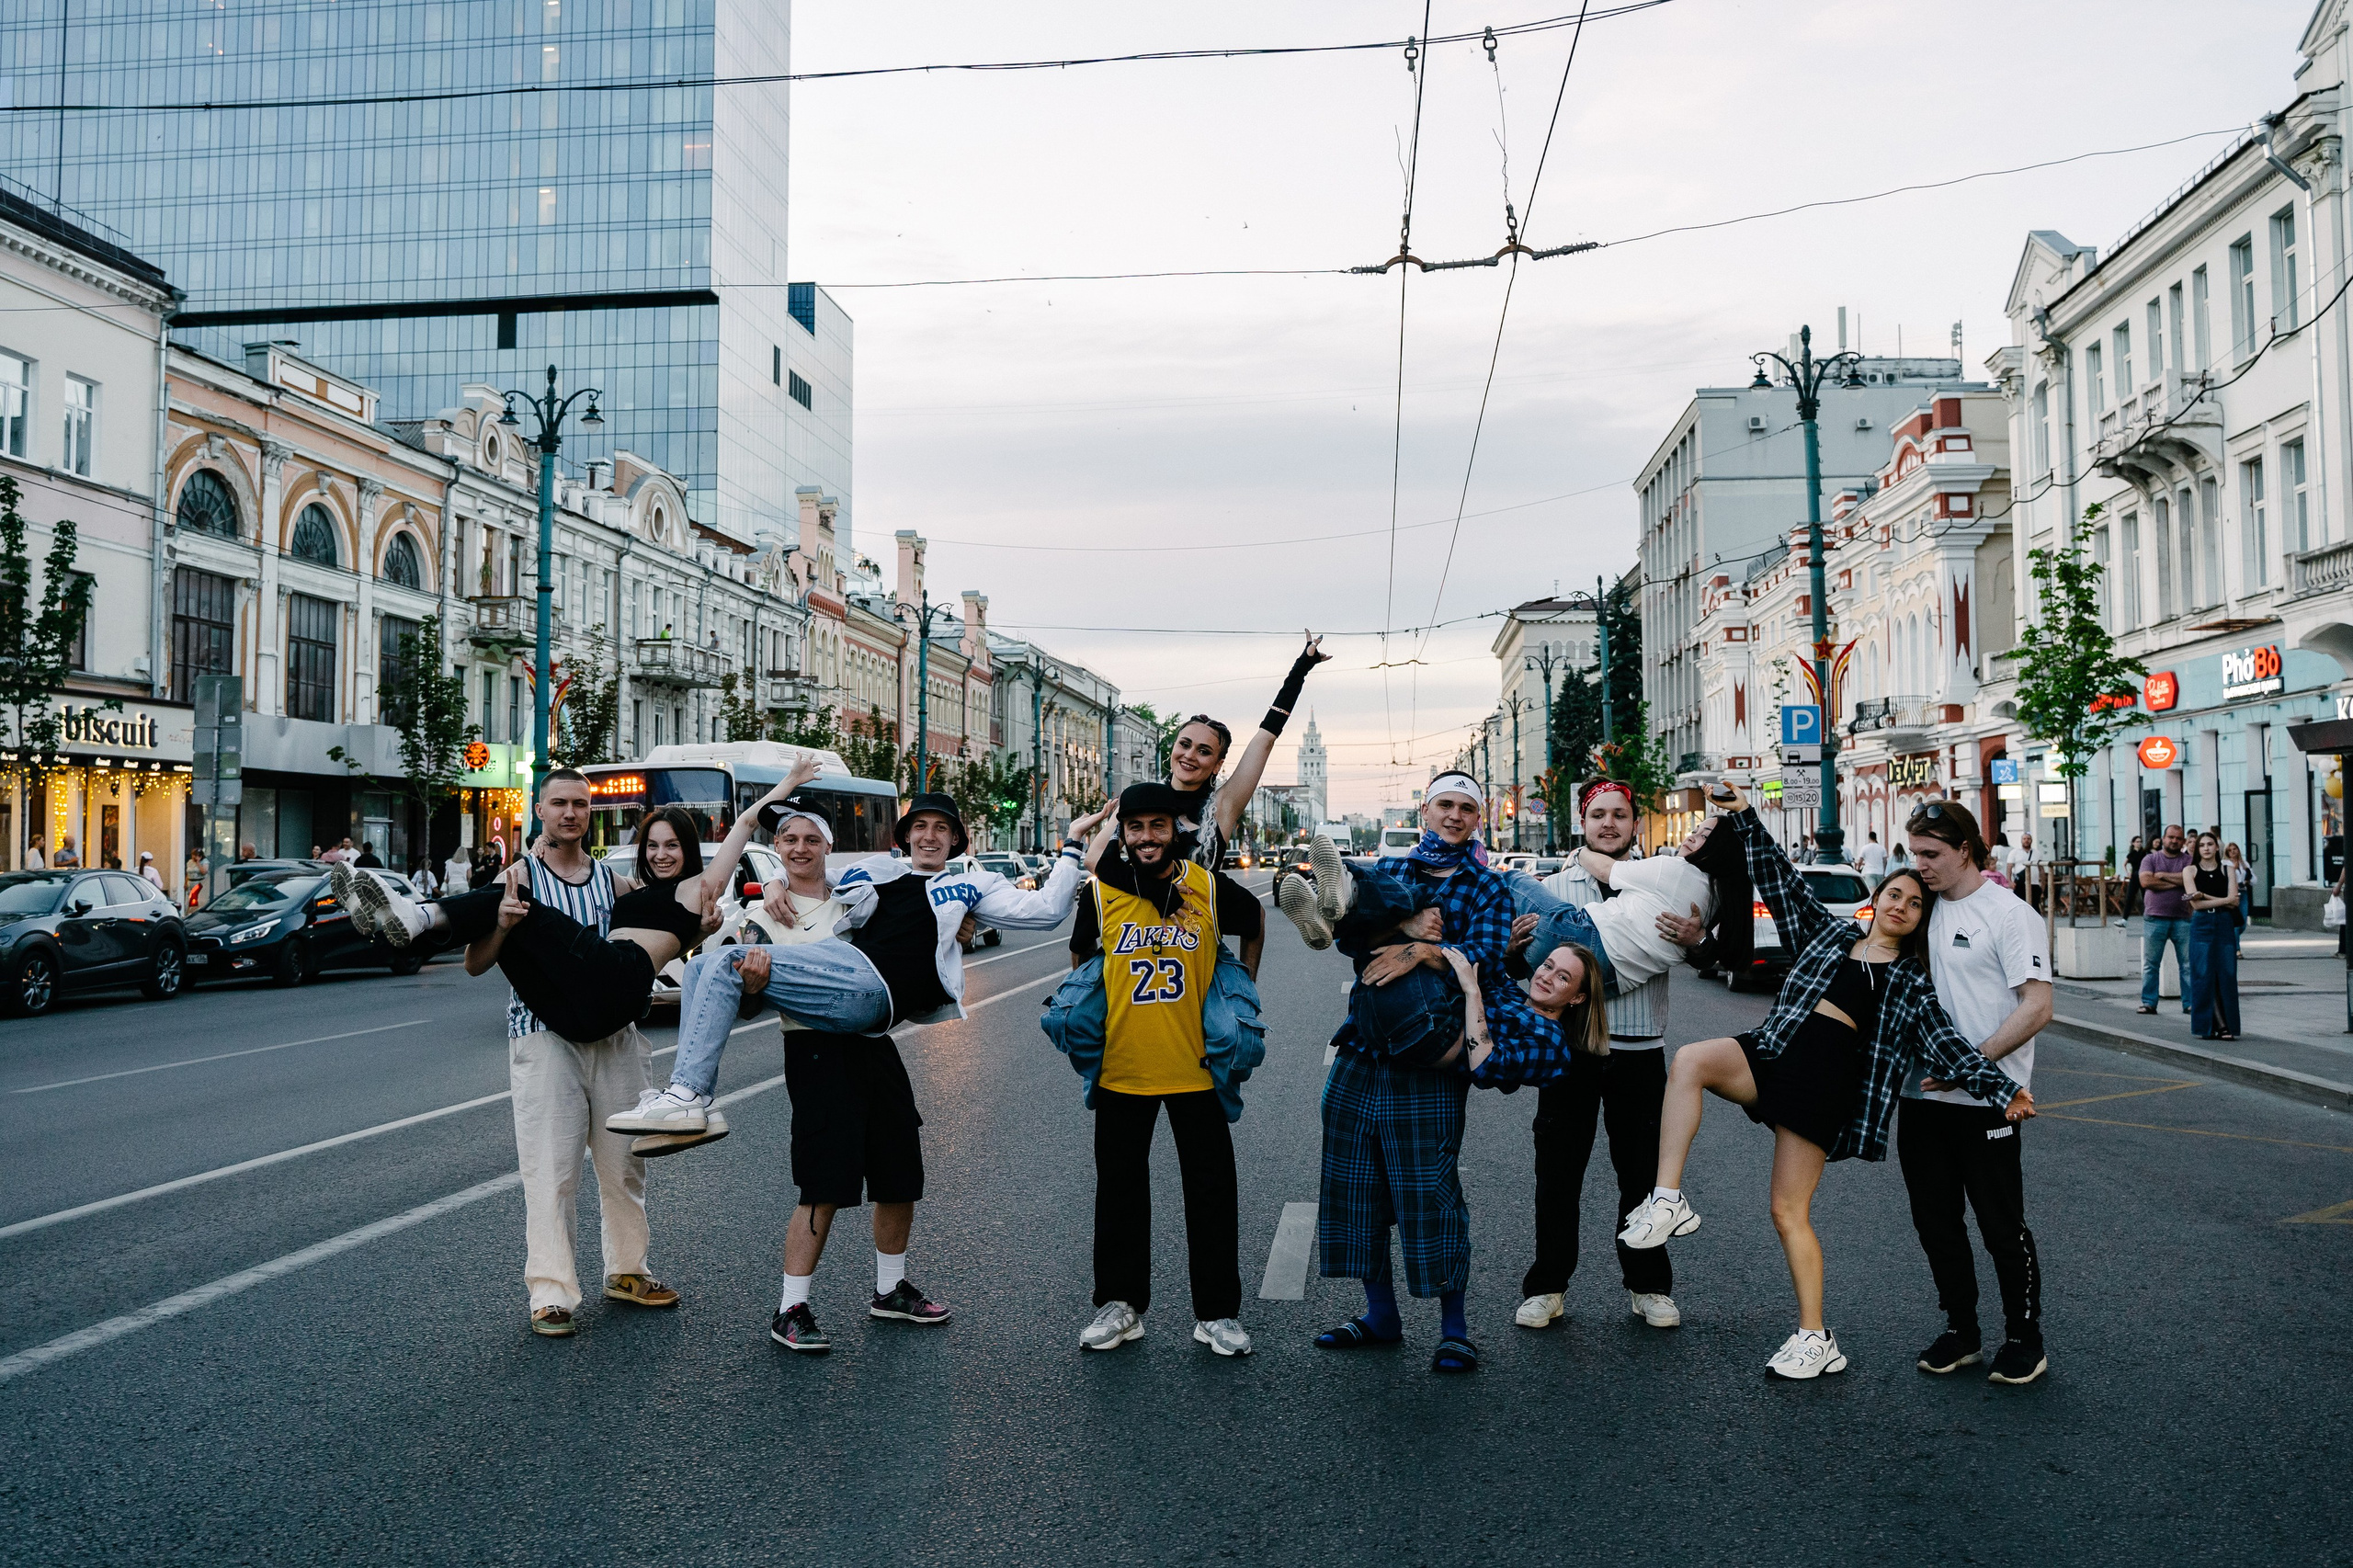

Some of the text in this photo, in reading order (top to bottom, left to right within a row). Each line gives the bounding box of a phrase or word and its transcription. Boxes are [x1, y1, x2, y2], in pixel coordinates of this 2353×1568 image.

[63, 705, 158, 747] biscuit
[1791, 710, 1814, 741] P
[1805, 793, 1817, 802] 20
[1112, 922, 1200, 955] LAKERS
[1130, 958, 1186, 1005] 23
[1986, 1125, 2013, 1140] PUMA
